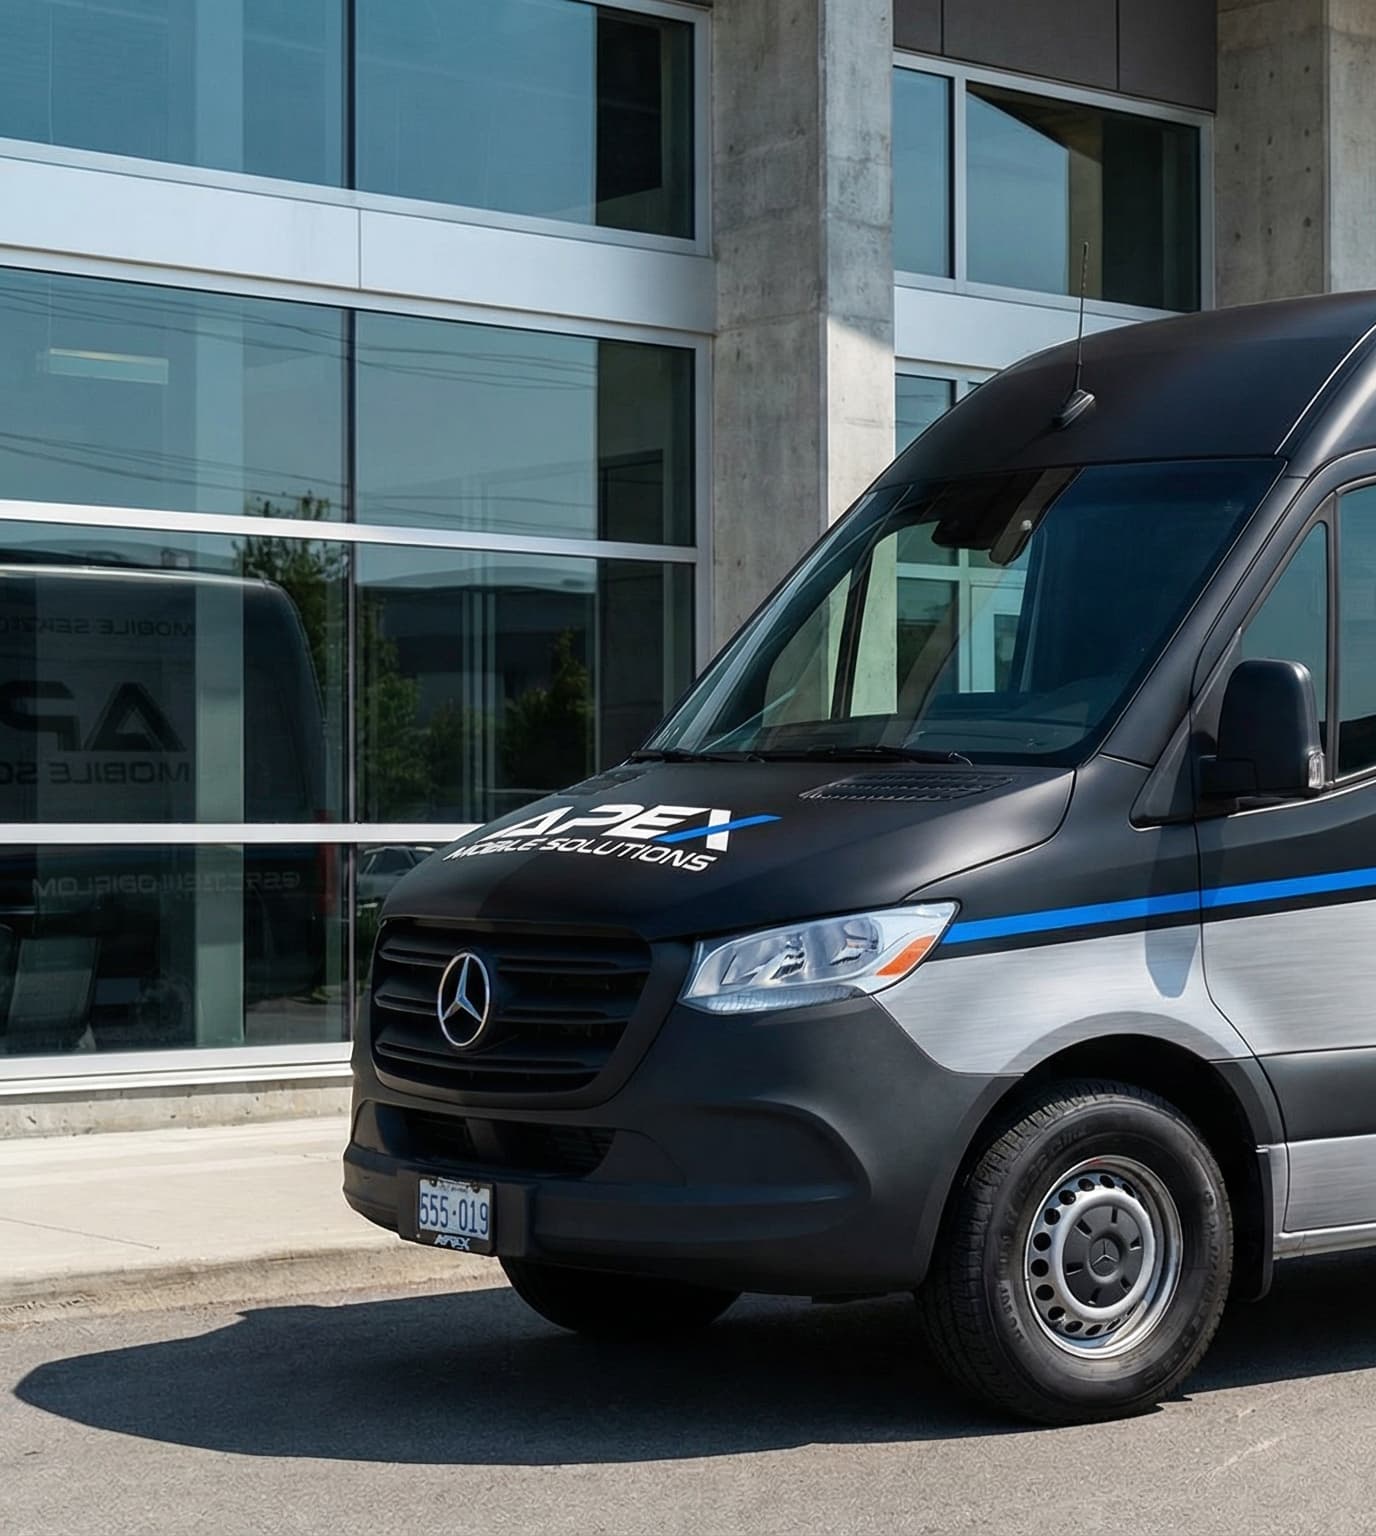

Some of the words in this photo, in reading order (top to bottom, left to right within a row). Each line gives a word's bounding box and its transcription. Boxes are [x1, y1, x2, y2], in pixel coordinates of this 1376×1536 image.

[475, 804, 783, 852] APEX
[442, 837, 548, 862] MOBILE
[538, 837, 718, 873] SOLUTIONS
